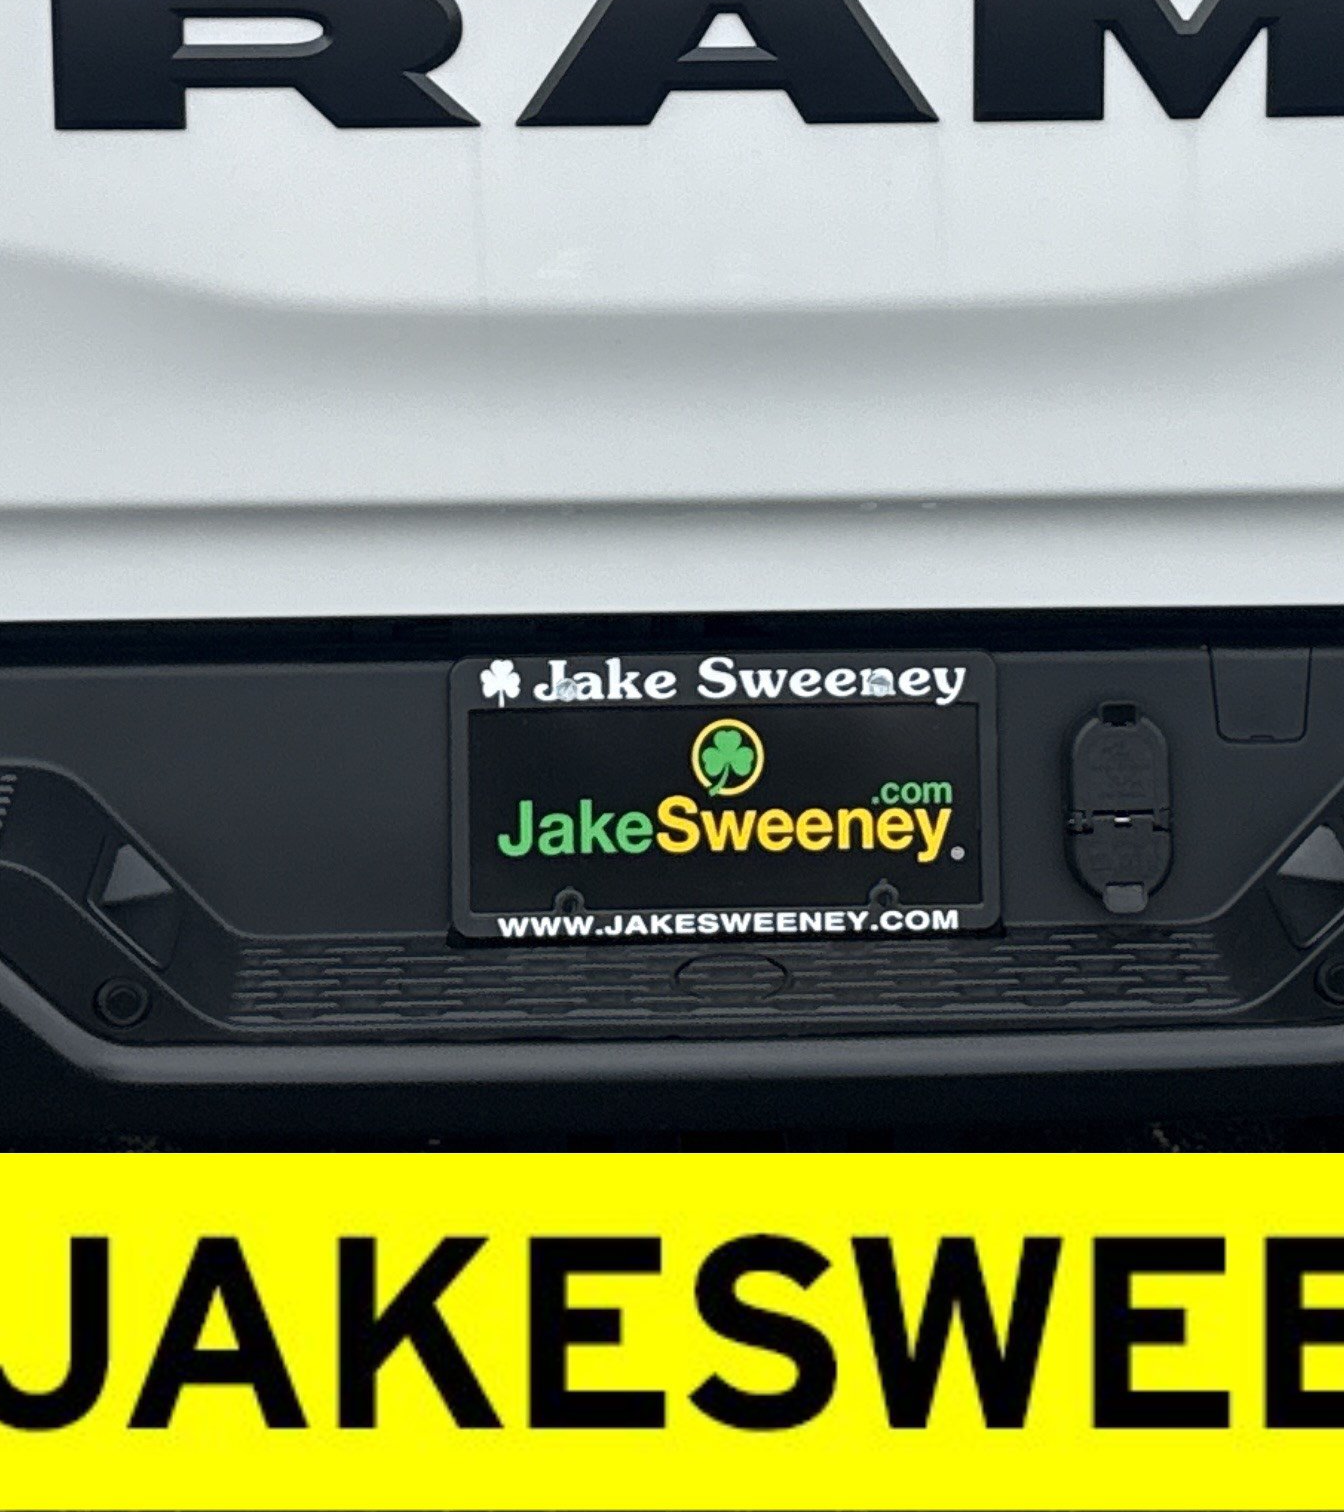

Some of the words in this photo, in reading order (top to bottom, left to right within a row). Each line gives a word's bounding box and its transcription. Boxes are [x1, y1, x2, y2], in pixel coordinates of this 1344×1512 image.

[534, 658, 677, 701] Jake
[697, 656, 967, 705] Sweeney
[498, 909, 959, 937] WWW.JAKESWEENEY.COM
